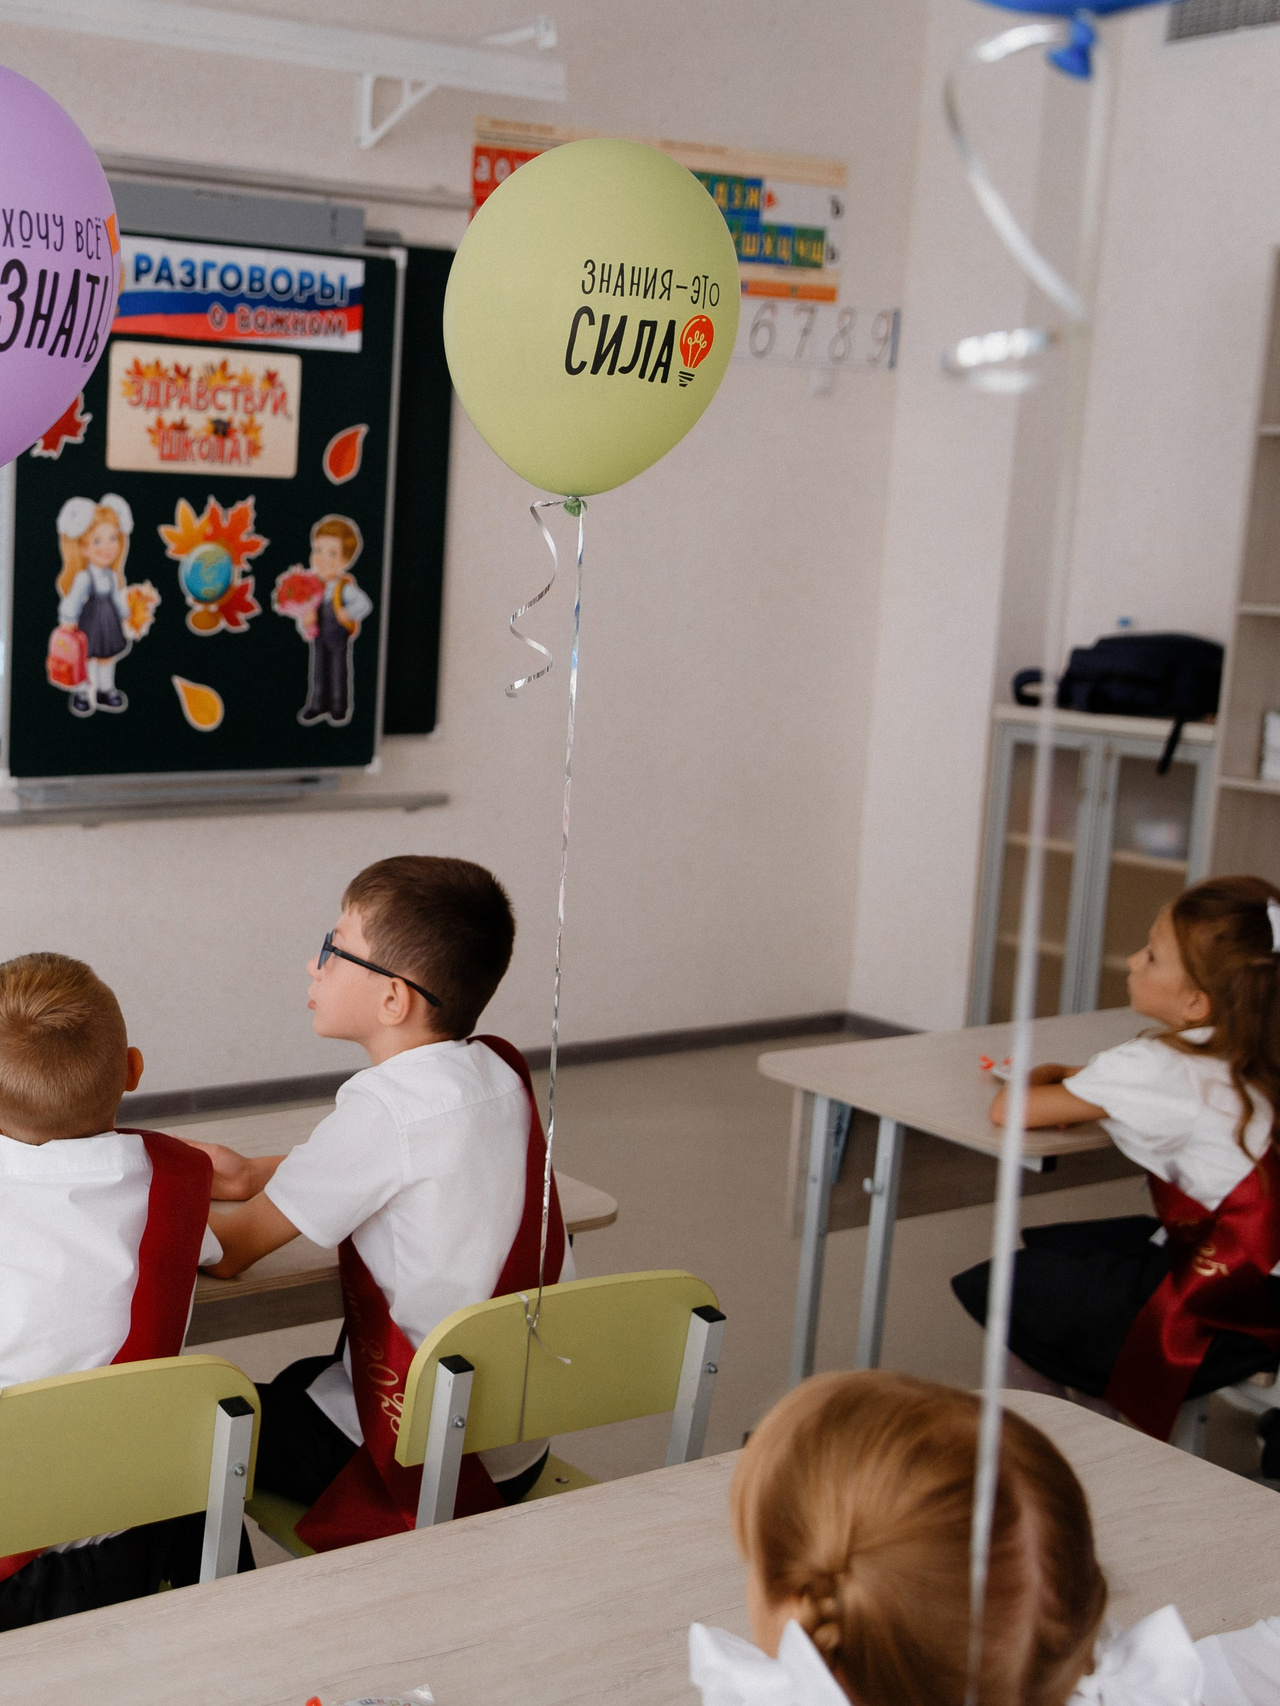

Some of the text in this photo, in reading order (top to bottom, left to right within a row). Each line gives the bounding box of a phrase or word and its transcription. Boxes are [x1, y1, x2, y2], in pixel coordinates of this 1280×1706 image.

[2, 208, 102, 260] ХОЧУ ВСЁ
[134, 253, 347, 302] РАЗГОВОРЫ
[565, 305, 677, 384] СИЛА
